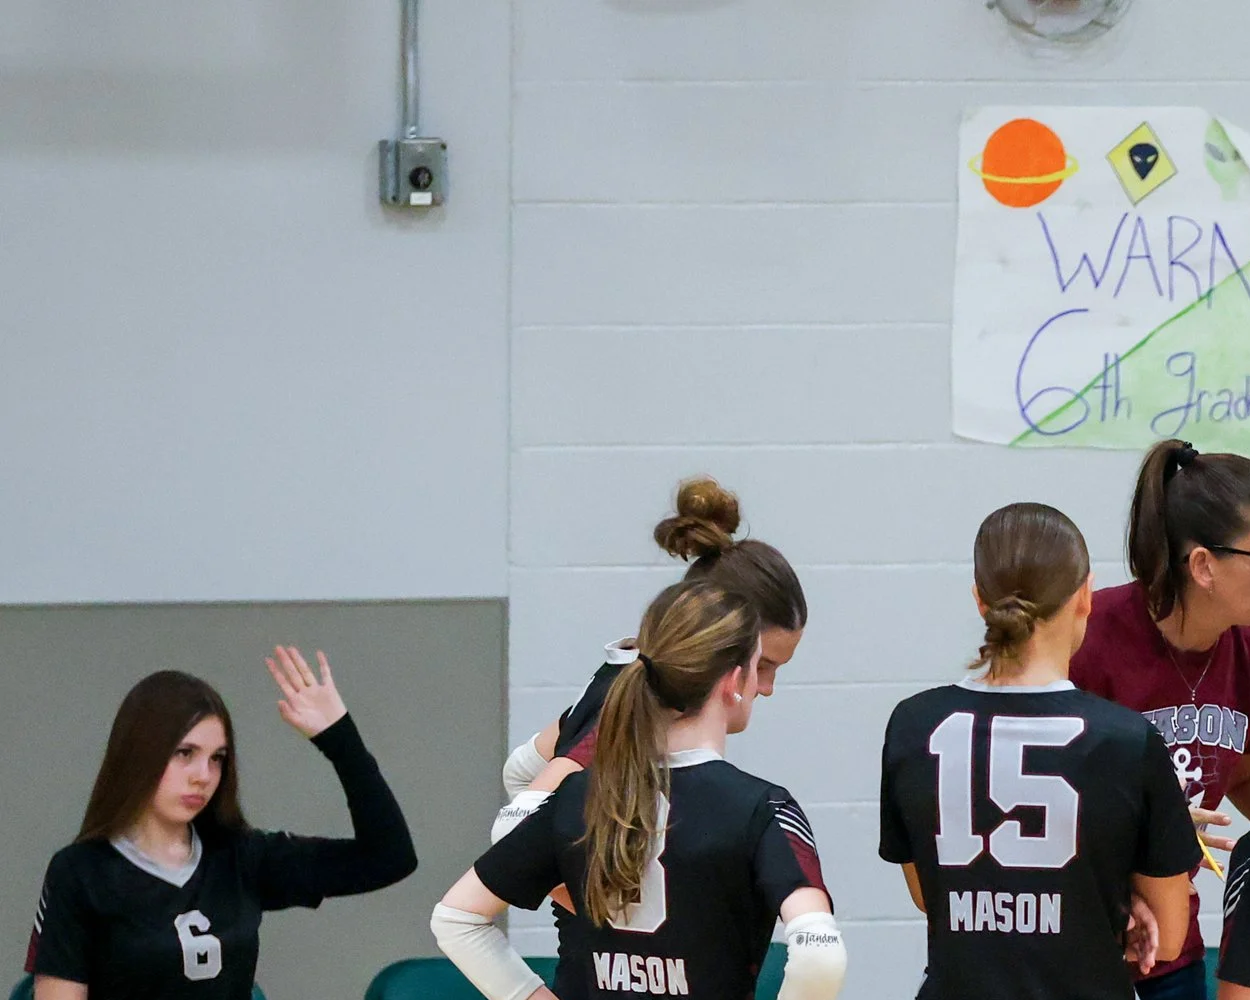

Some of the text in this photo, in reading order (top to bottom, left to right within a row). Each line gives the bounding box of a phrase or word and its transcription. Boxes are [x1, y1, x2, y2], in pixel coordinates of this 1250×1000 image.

[1015, 308, 1133, 437] 6th
[1141, 703, 1249, 754] ASON
[928, 711, 1085, 868] 15
[949, 890, 1061, 934] MASON
[174, 909, 222, 981] 6
[592, 951, 690, 996] MASON
